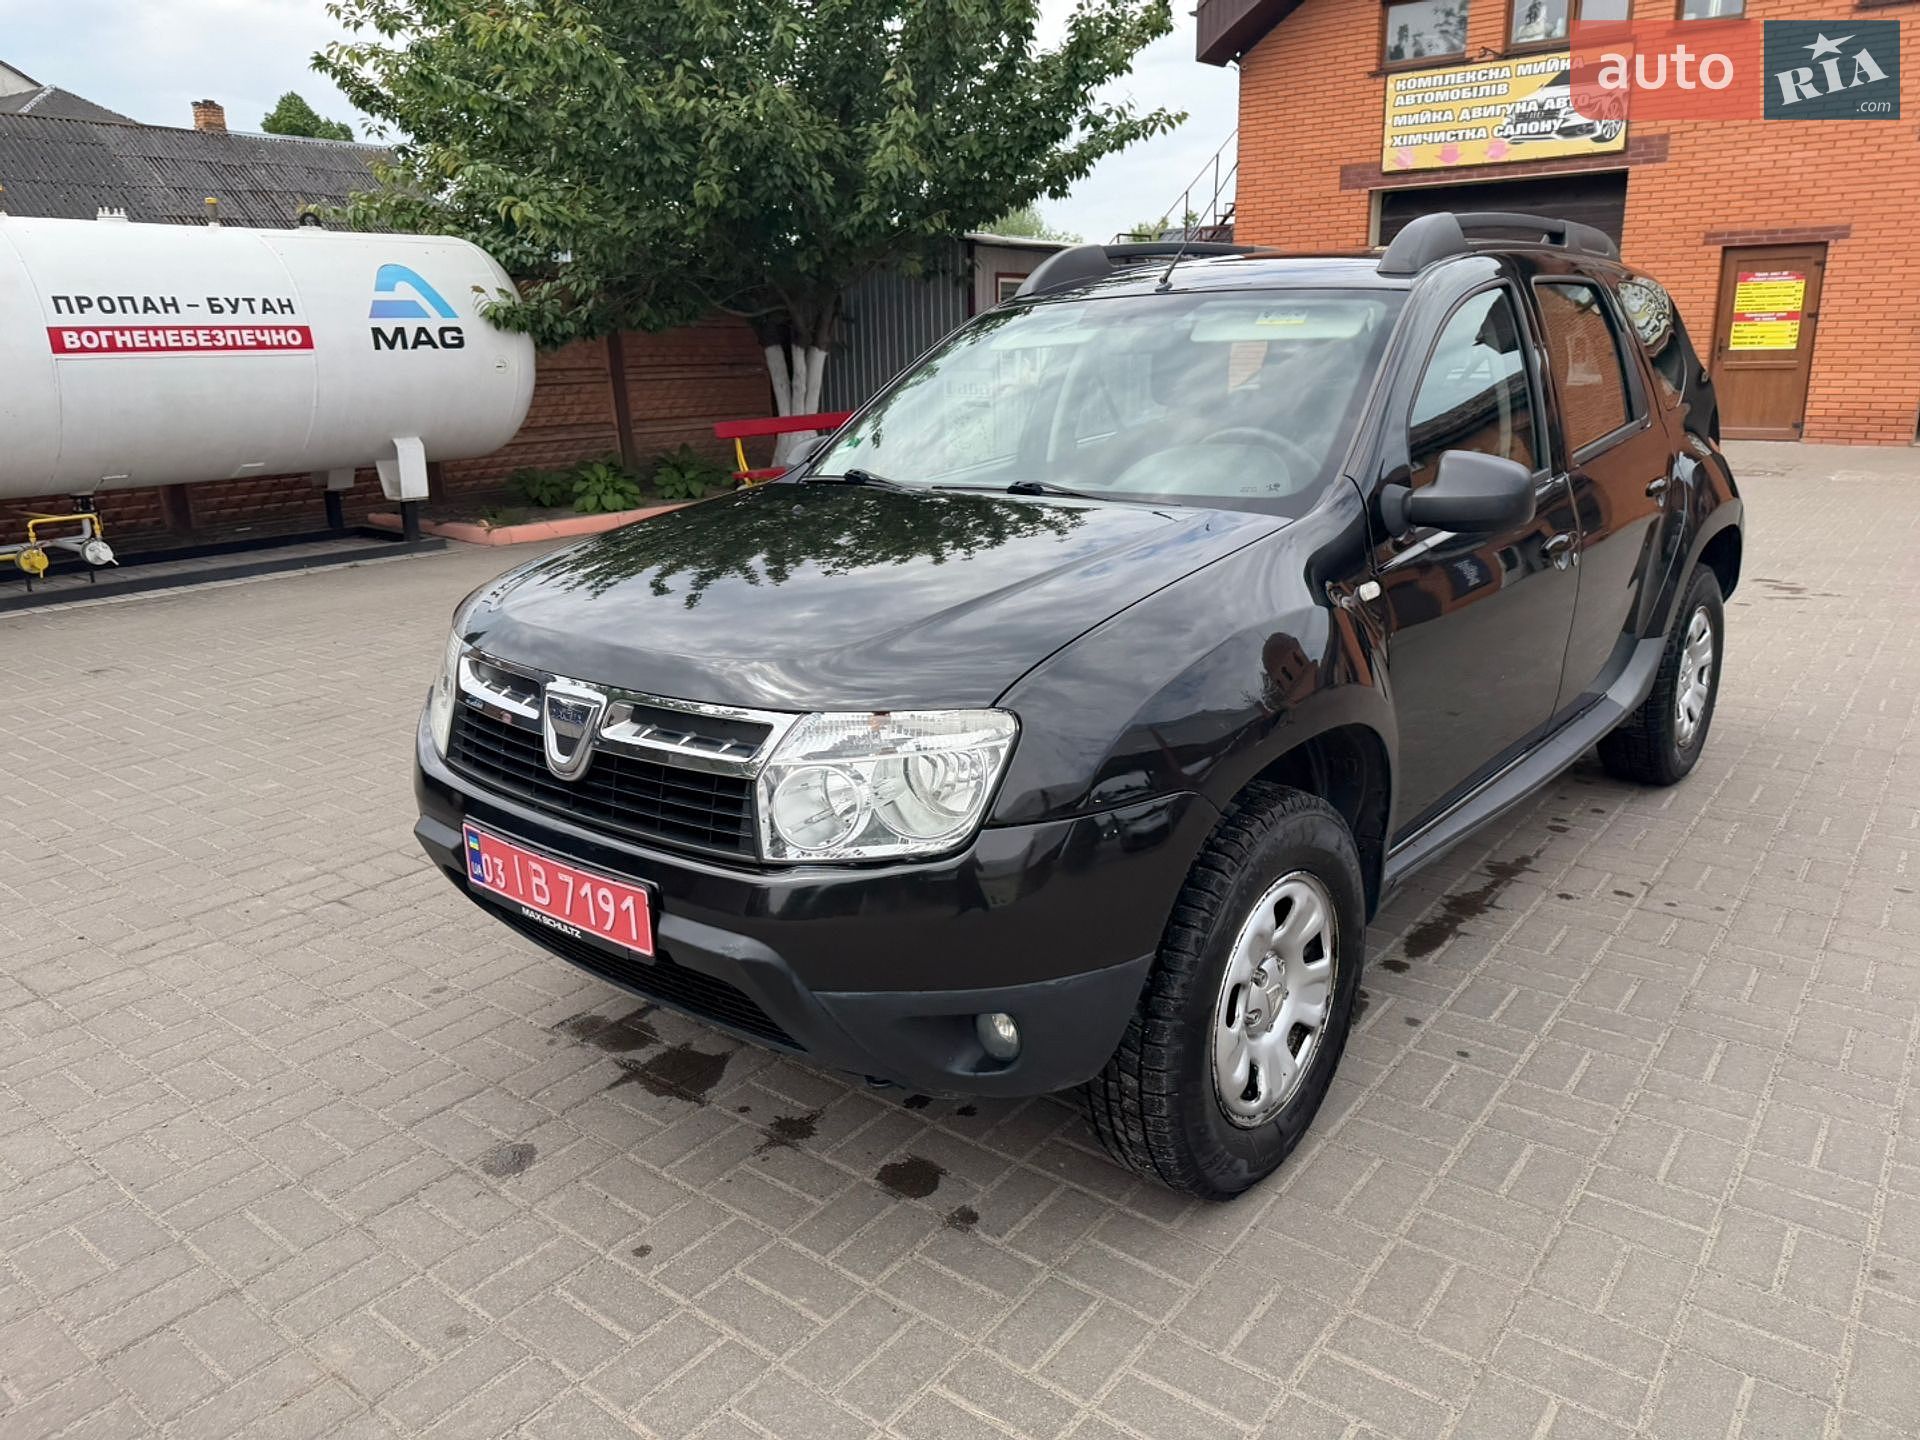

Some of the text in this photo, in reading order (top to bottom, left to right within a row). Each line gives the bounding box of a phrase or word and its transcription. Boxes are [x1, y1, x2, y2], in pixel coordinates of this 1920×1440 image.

[1395, 56, 1585, 91] КОМПЛЕКСНА МИЙКА
[1394, 83, 1509, 107] АВТОМОБІЛІВ
[1392, 110, 1455, 127] МИЙКА
[1458, 100, 1539, 122] ДВИГУНА
[1391, 118, 1565, 147] ХІМЧИСТКА САЛОНУ
[51, 295, 180, 316] ПРОПАН
[206, 297, 296, 315] БУТАН
[63, 328, 303, 350] ВОГНЕНЕБЕЗПЕЧНО
[371, 326, 465, 351] MAG
[481, 853, 506, 889] 03
[558, 872, 638, 941] 7191
[521, 906, 582, 939] MAX SCHULTZ
